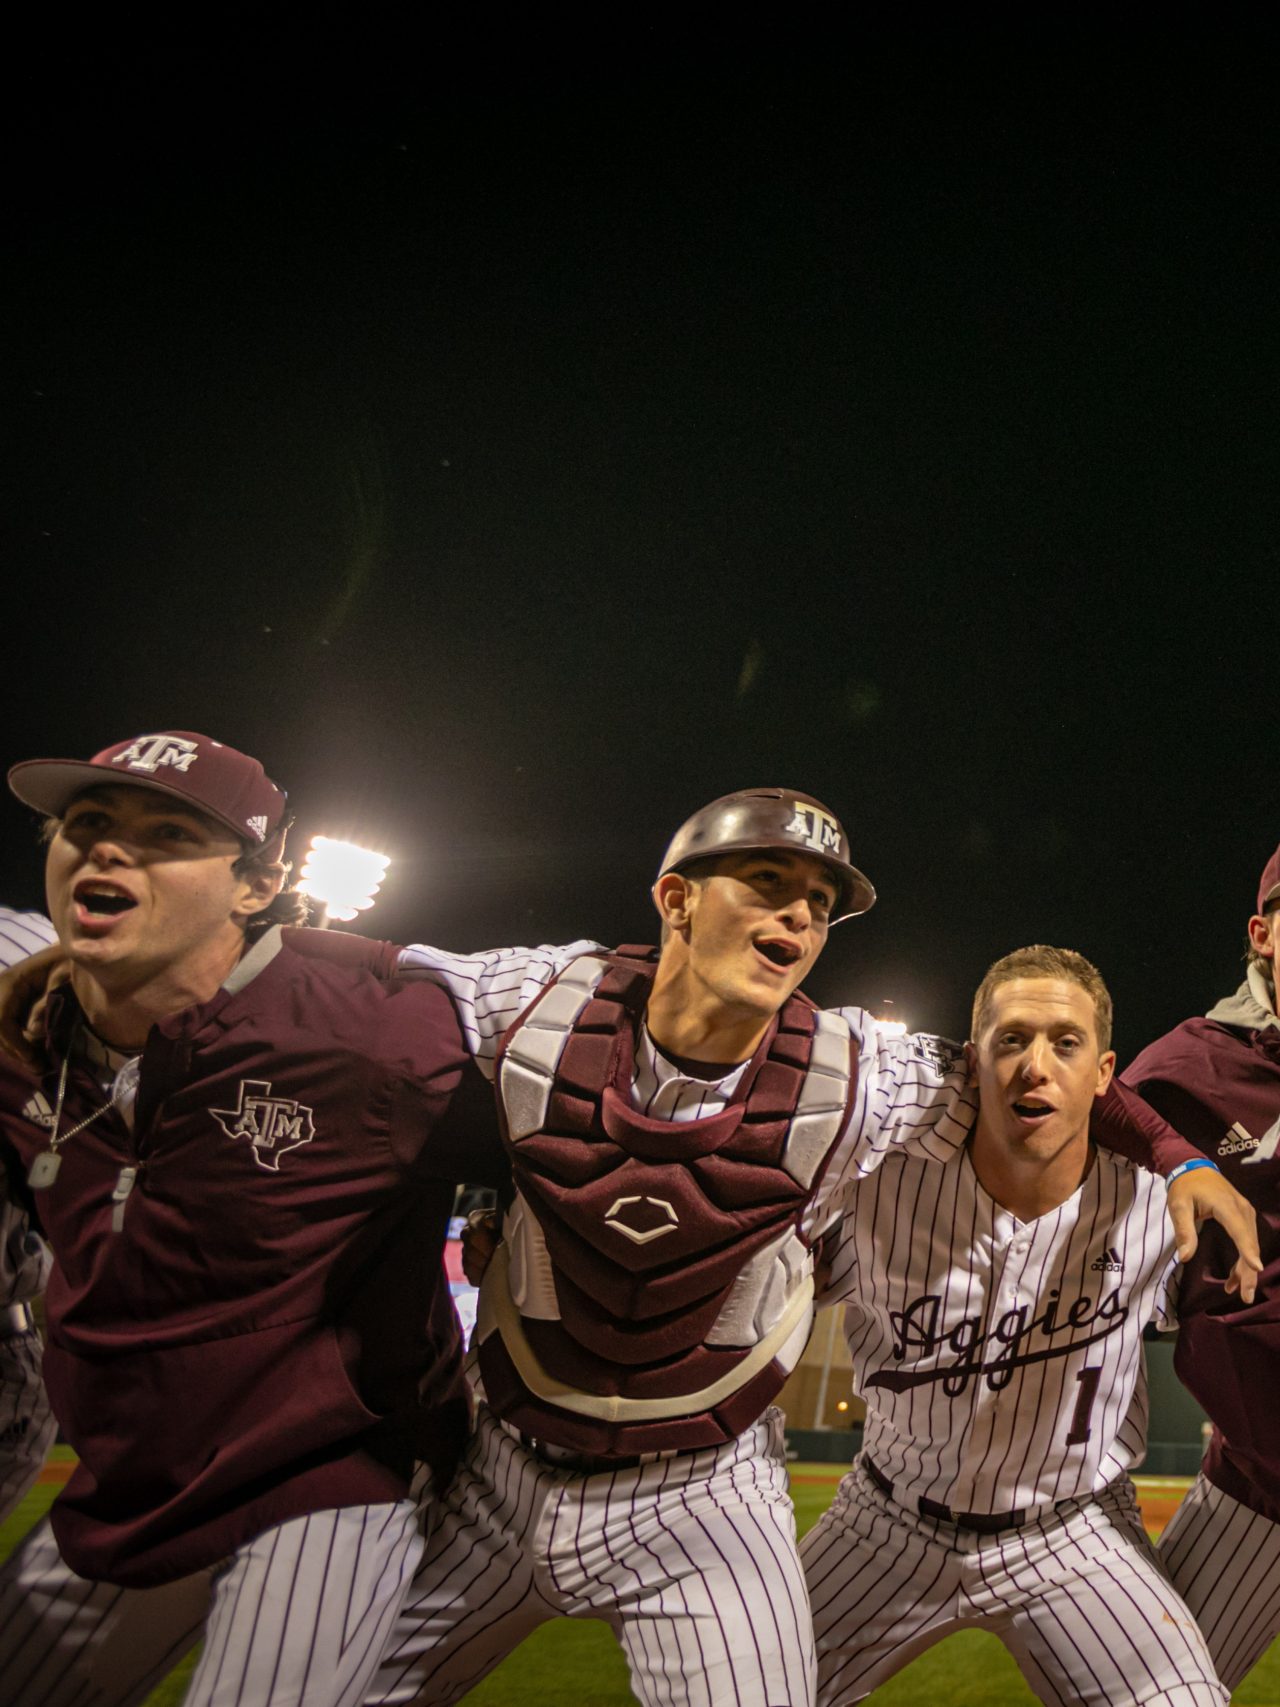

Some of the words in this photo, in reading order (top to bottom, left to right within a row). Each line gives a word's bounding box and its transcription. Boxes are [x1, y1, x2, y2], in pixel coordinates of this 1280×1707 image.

[1217, 1138, 1261, 1156] adidas
[889, 1287, 1124, 1398] Aggies
[1065, 1366, 1103, 1446] 1
